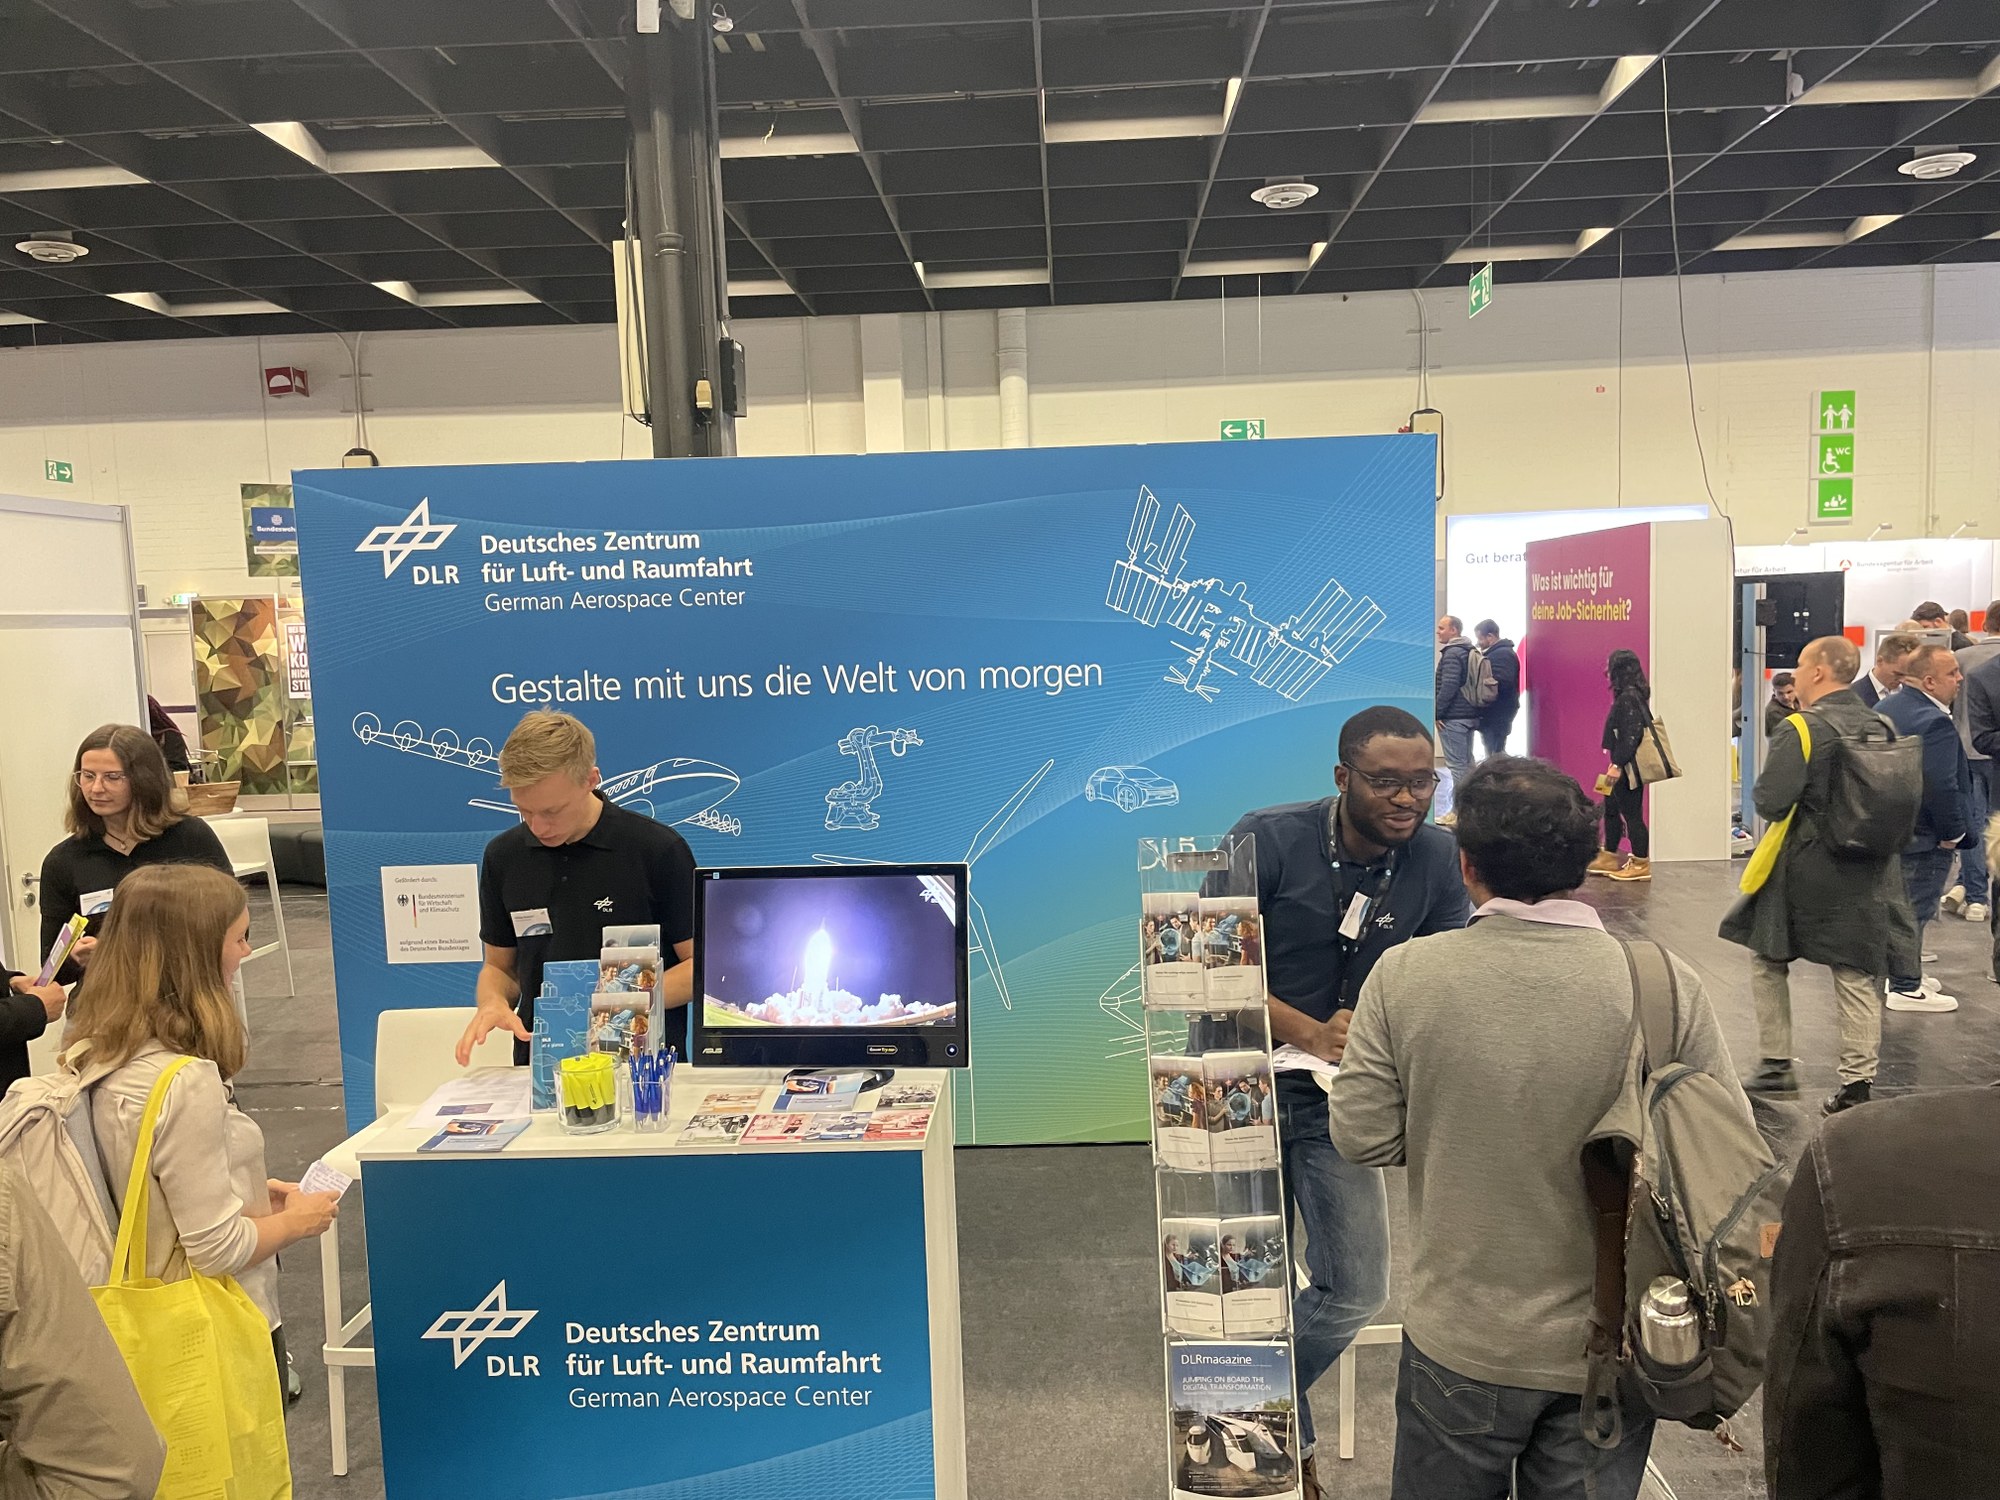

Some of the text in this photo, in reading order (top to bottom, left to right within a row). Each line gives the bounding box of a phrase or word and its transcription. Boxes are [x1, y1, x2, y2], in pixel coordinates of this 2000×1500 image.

[1835, 447, 1851, 455] WC
[256, 525, 297, 533] Bundesweh
[480, 530, 700, 555] Deutsches Zentrum
[481, 556, 754, 584] für Luft- und Raumfahrt
[1465, 552, 1488, 564] Gut
[1764, 565, 1786, 573] Arbeit
[412, 565, 460, 585] DLR
[1531, 566, 1614, 596] Was ist wichtig für
[484, 588, 746, 613] German Aerospace Center
[1531, 597, 1632, 621] deine Job-Sicherheit?
[491, 661, 1103, 704] Gestalte mit uns die Welt von morgen
[565, 1320, 820, 1344] Deutsches Zentrum
[486, 1355, 541, 1377] DLR
[566, 1350, 882, 1376] für Luft- und Raumfahrt
[1181, 1353, 1253, 1365] DLRmagazine
[568, 1385, 873, 1411] German Aerospace Center
